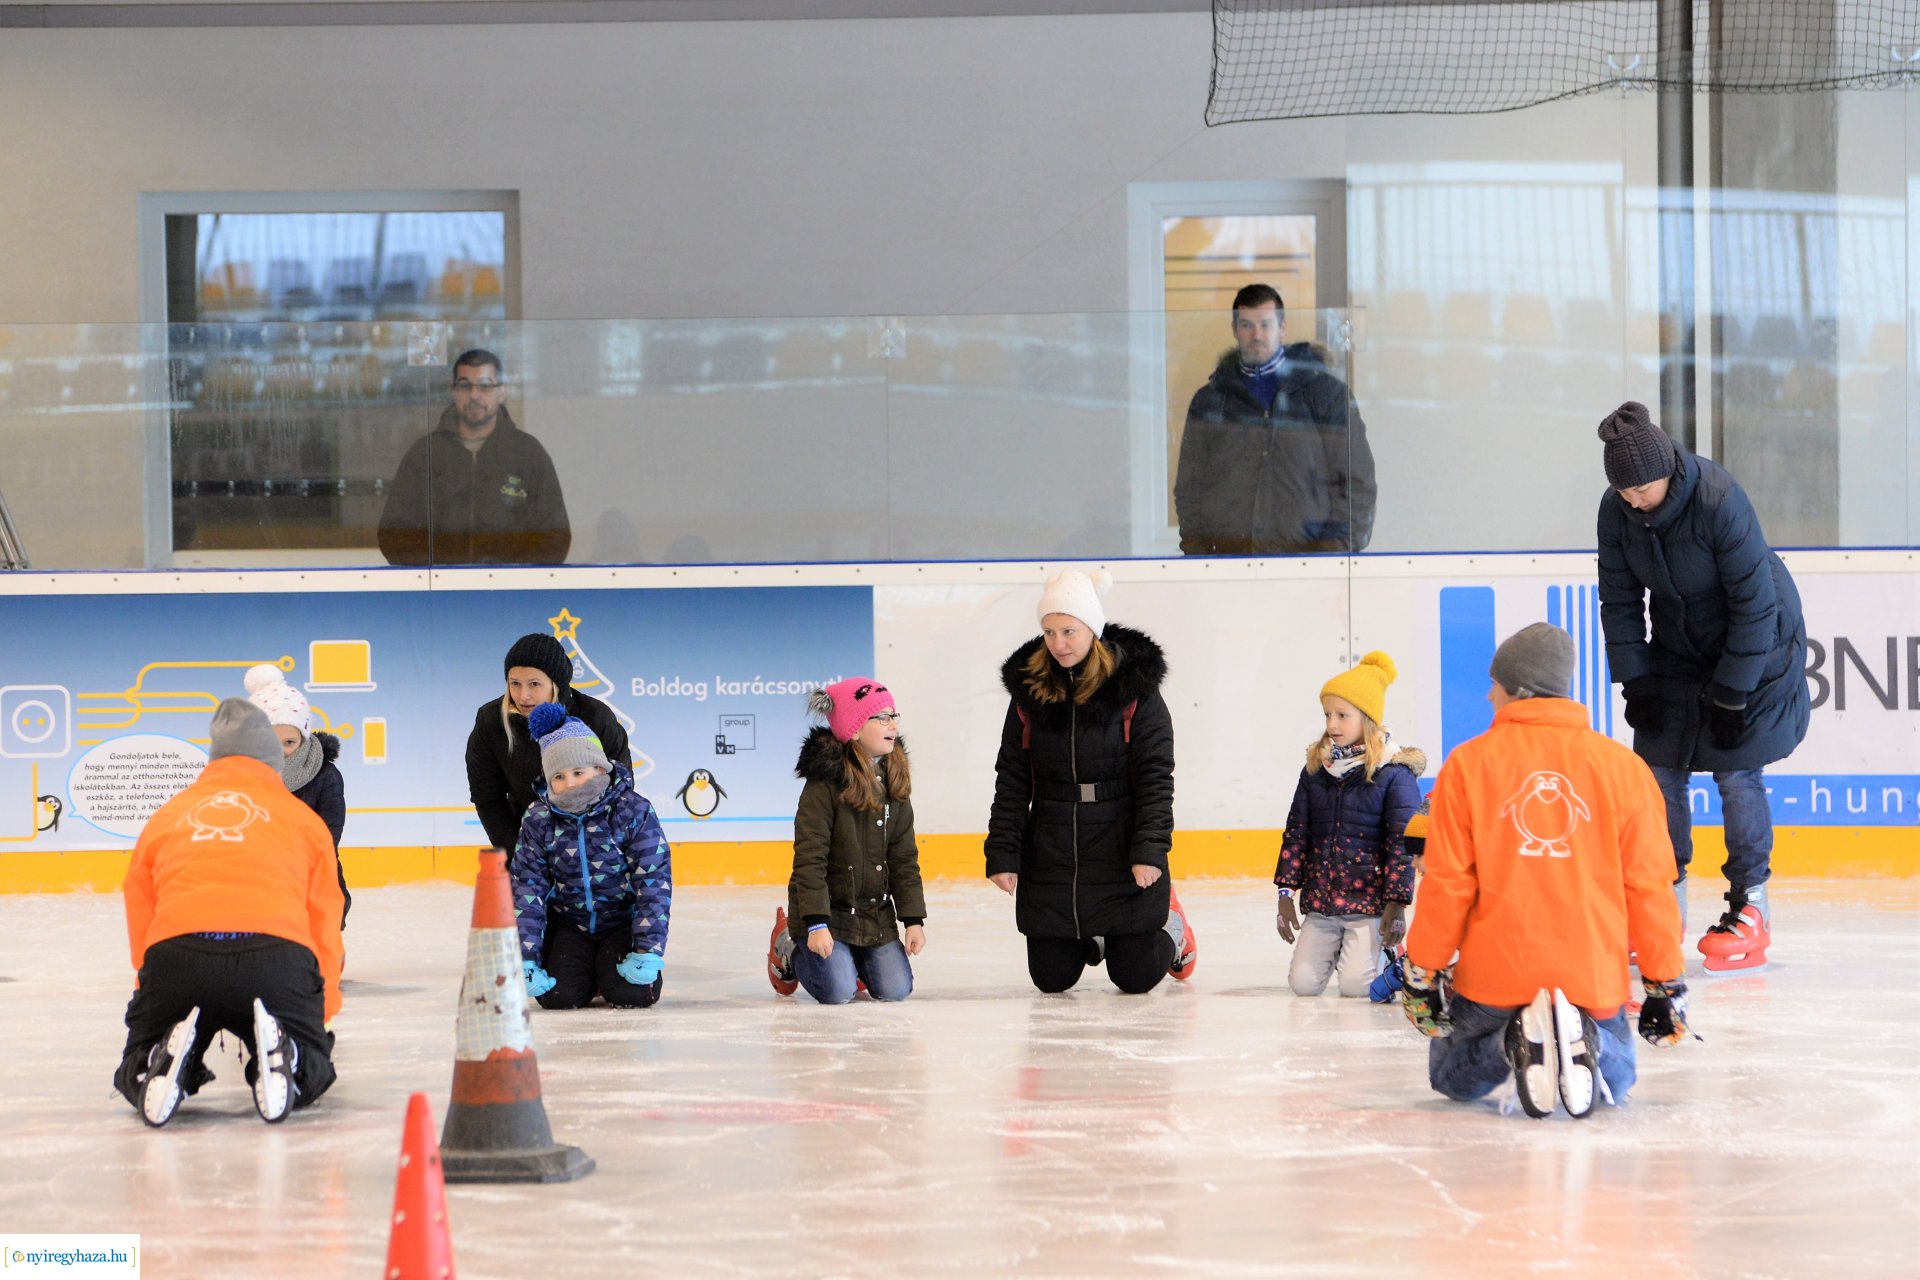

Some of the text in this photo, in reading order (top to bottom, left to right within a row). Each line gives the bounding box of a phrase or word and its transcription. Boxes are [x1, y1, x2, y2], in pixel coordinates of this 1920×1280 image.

[631, 676, 708, 701] Boldog
[724, 719, 750, 727] group
[109, 752, 182, 761] Gondoljatok bele,
[84, 763, 105, 772] hogy
[107, 763, 137, 772] mennyi
[73, 783, 128, 791] iskolátokban.
[173, 782, 192, 790] elek
[126, 793, 167, 801] telefonok,
